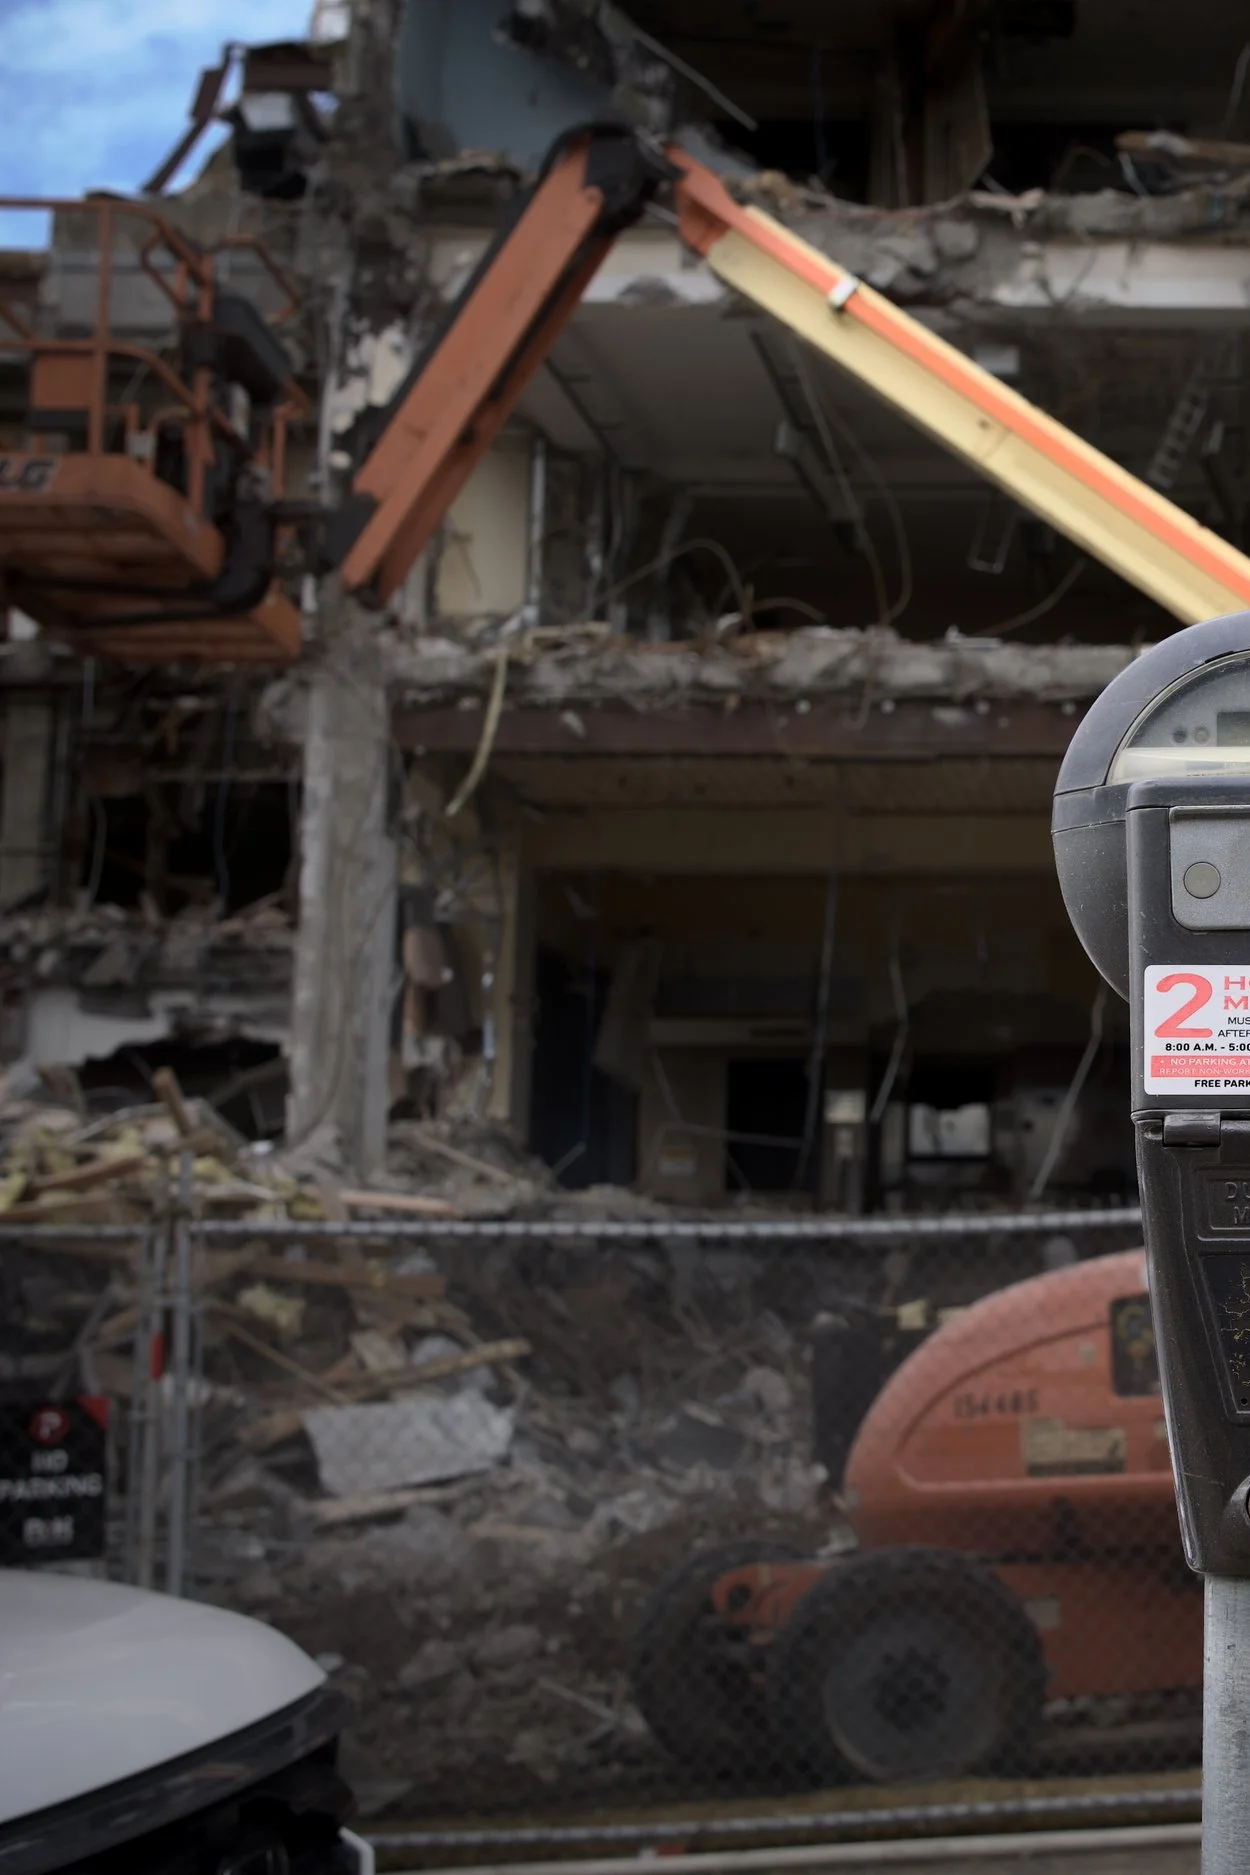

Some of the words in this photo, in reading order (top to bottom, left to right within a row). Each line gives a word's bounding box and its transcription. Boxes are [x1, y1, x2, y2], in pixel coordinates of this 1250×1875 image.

[1154, 973, 1213, 1038] 2
[1165, 1043, 1190, 1051] 8:00
[1193, 1043, 1217, 1051] A.M.
[1170, 1058, 1186, 1066] NO
[1188, 1058, 1237, 1066] PARKING
[1194, 1080, 1221, 1088] FREE
